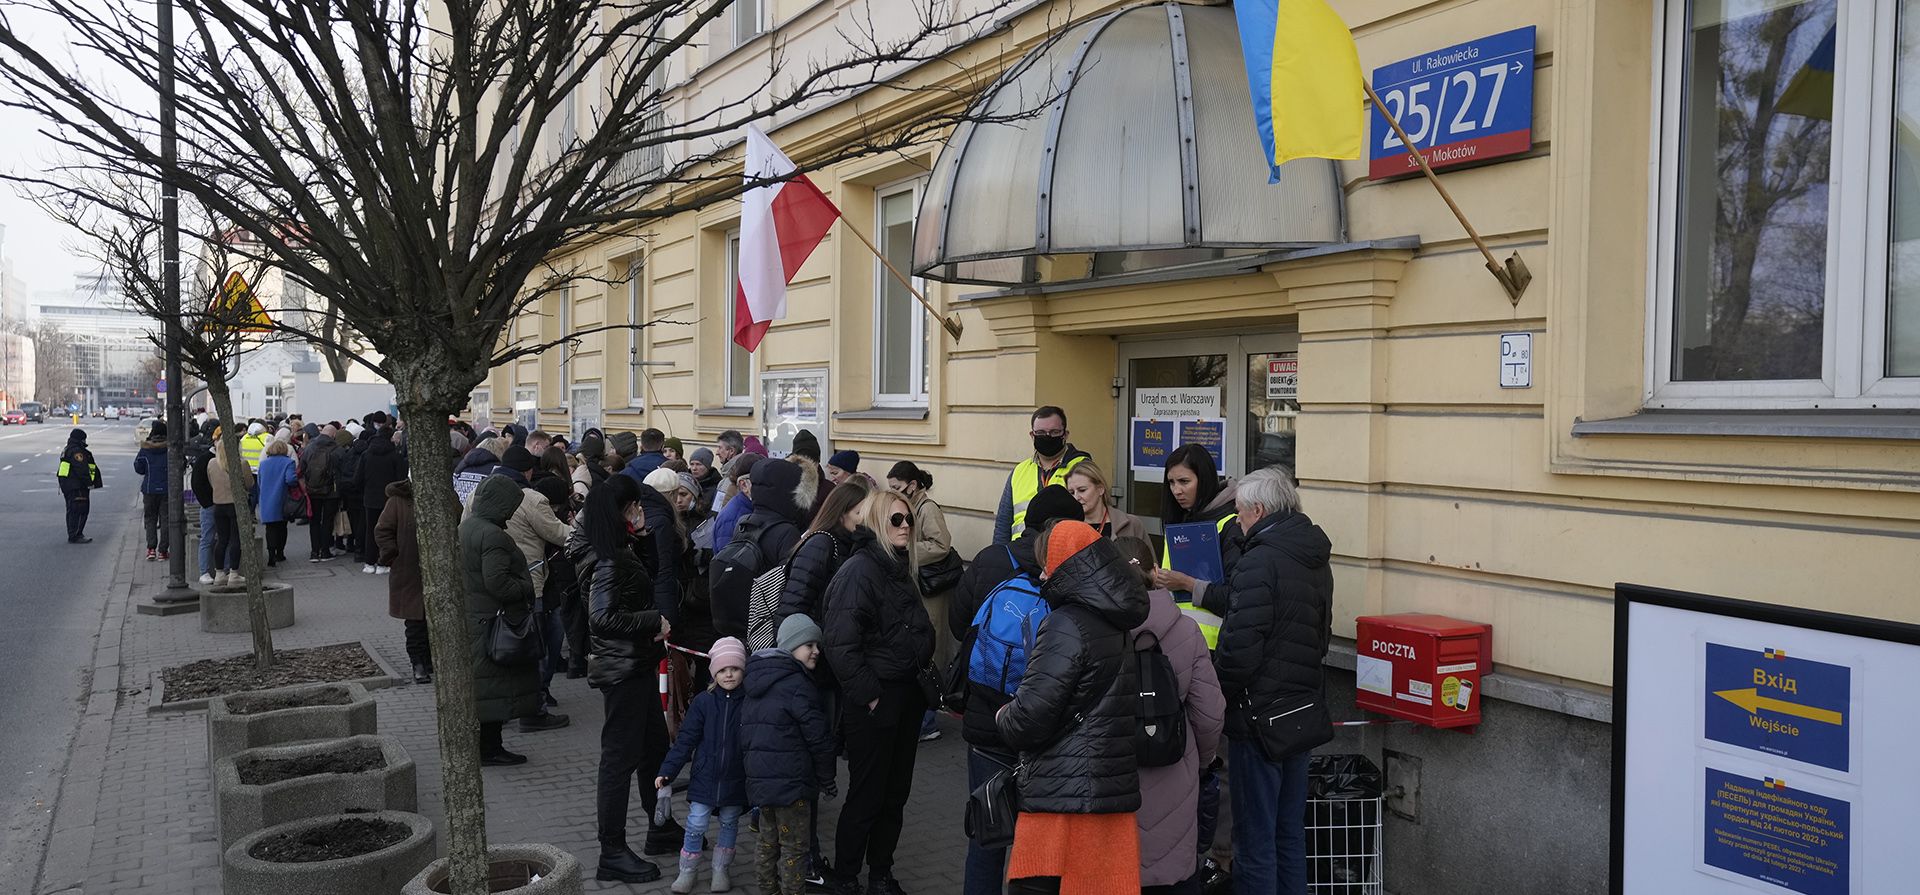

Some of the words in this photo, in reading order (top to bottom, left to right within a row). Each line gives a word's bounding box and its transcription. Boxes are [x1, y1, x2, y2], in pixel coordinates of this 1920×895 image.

[1412, 59, 1422, 74] Ul.
[1426, 46, 1479, 71] Rakowiecka
[1383, 62, 1508, 150] 25/27
[1408, 154, 1430, 168] Sty
[1432, 144, 1477, 163] Mokotów
[1502, 341, 1511, 356] D
[1273, 362, 1296, 372] UWAG
[1270, 376, 1287, 384] OBIEKT
[1141, 392, 1159, 407] Urząd
[1160, 395, 1169, 404] m.
[1170, 394, 1178, 404] st.
[1179, 393, 1215, 407] Warszawy
[1153, 408, 1180, 417] Zapraszamy
[1145, 428, 1162, 441] Вхід
[1142, 446, 1165, 457] Wejście
[1372, 639, 1416, 660] POCZTA
[1753, 667, 1798, 695] Вхід
[1749, 714, 1800, 737] Wejście
[1763, 822, 1772, 830] 24
[1801, 832, 1820, 844] 2022
